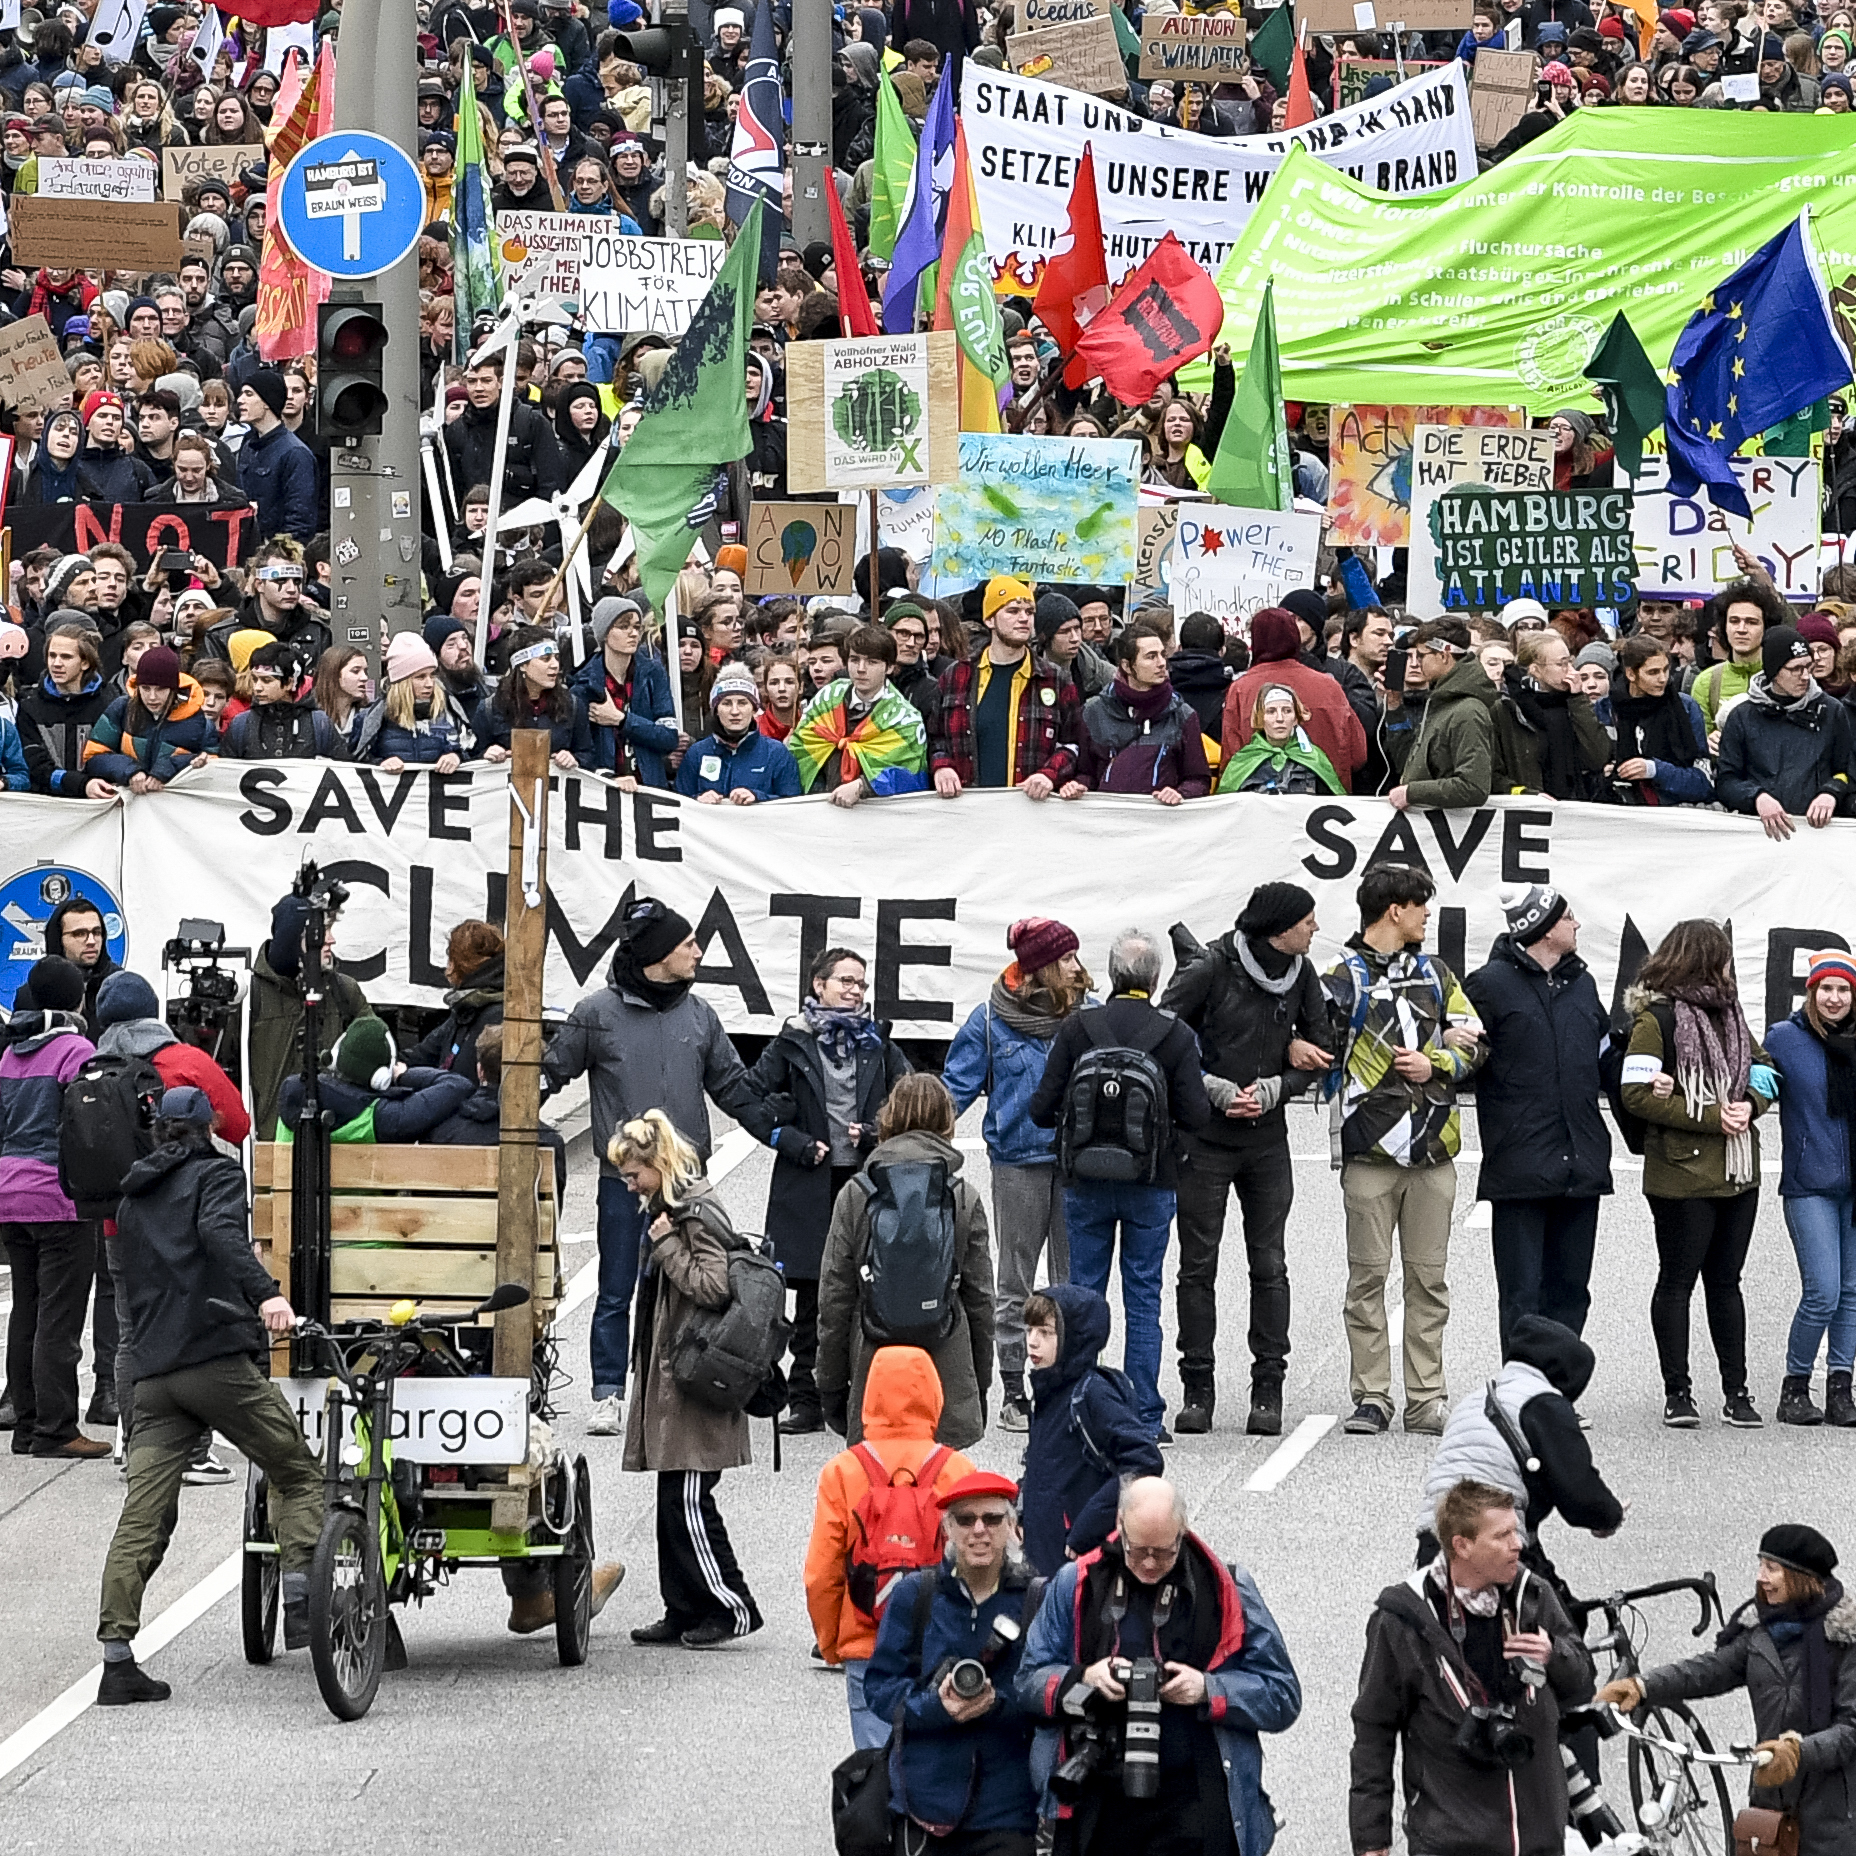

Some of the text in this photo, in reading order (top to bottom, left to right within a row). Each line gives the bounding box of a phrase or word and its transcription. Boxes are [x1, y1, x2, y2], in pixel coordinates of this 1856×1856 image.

[1161, 17, 1236, 37] ACT NOW
[1148, 41, 1201, 69] SWIM
[1201, 44, 1244, 70] LATER
[976, 82, 1456, 127] STAAT HAND
[170, 151, 228, 175] Vote
[306, 162, 374, 183] HAMBURG IST
[1107, 147, 1458, 204] UNSERE BRAND
[310, 198, 346, 213] BRAUN
[1552, 181, 1649, 201] Kontrolle
[1651, 184, 1685, 204] der
[503, 214, 586, 234] DAS KLIMA
[582, 234, 724, 280] JOBBSTREJK
[1459, 239, 1603, 259] Fluchtursache
[637, 274, 679, 294] FÖR
[12, 347, 57, 376] heute
[833, 342, 917, 358] Vollhöfner Wald
[833, 353, 917, 371] ABHOLZEN?
[1423, 431, 1549, 462] DIE ERDE
[833, 456, 855, 467] DAS
[958, 444, 1058, 477] Wir wollen
[1417, 459, 1468, 485] HAT
[1442, 494, 1626, 535] HAMBURG
[74, 502, 255, 569] NOT
[1011, 526, 1068, 552] Plastic
[1250, 549, 1285, 577] THE
[1446, 535, 1631, 567] IST GEILER ALS
[1010, 554, 1081, 578] Fantastic
[1443, 566, 1632, 606] ATLANTIS
[239, 766, 473, 842] SAVE
[1302, 804, 1553, 886] SAVE
